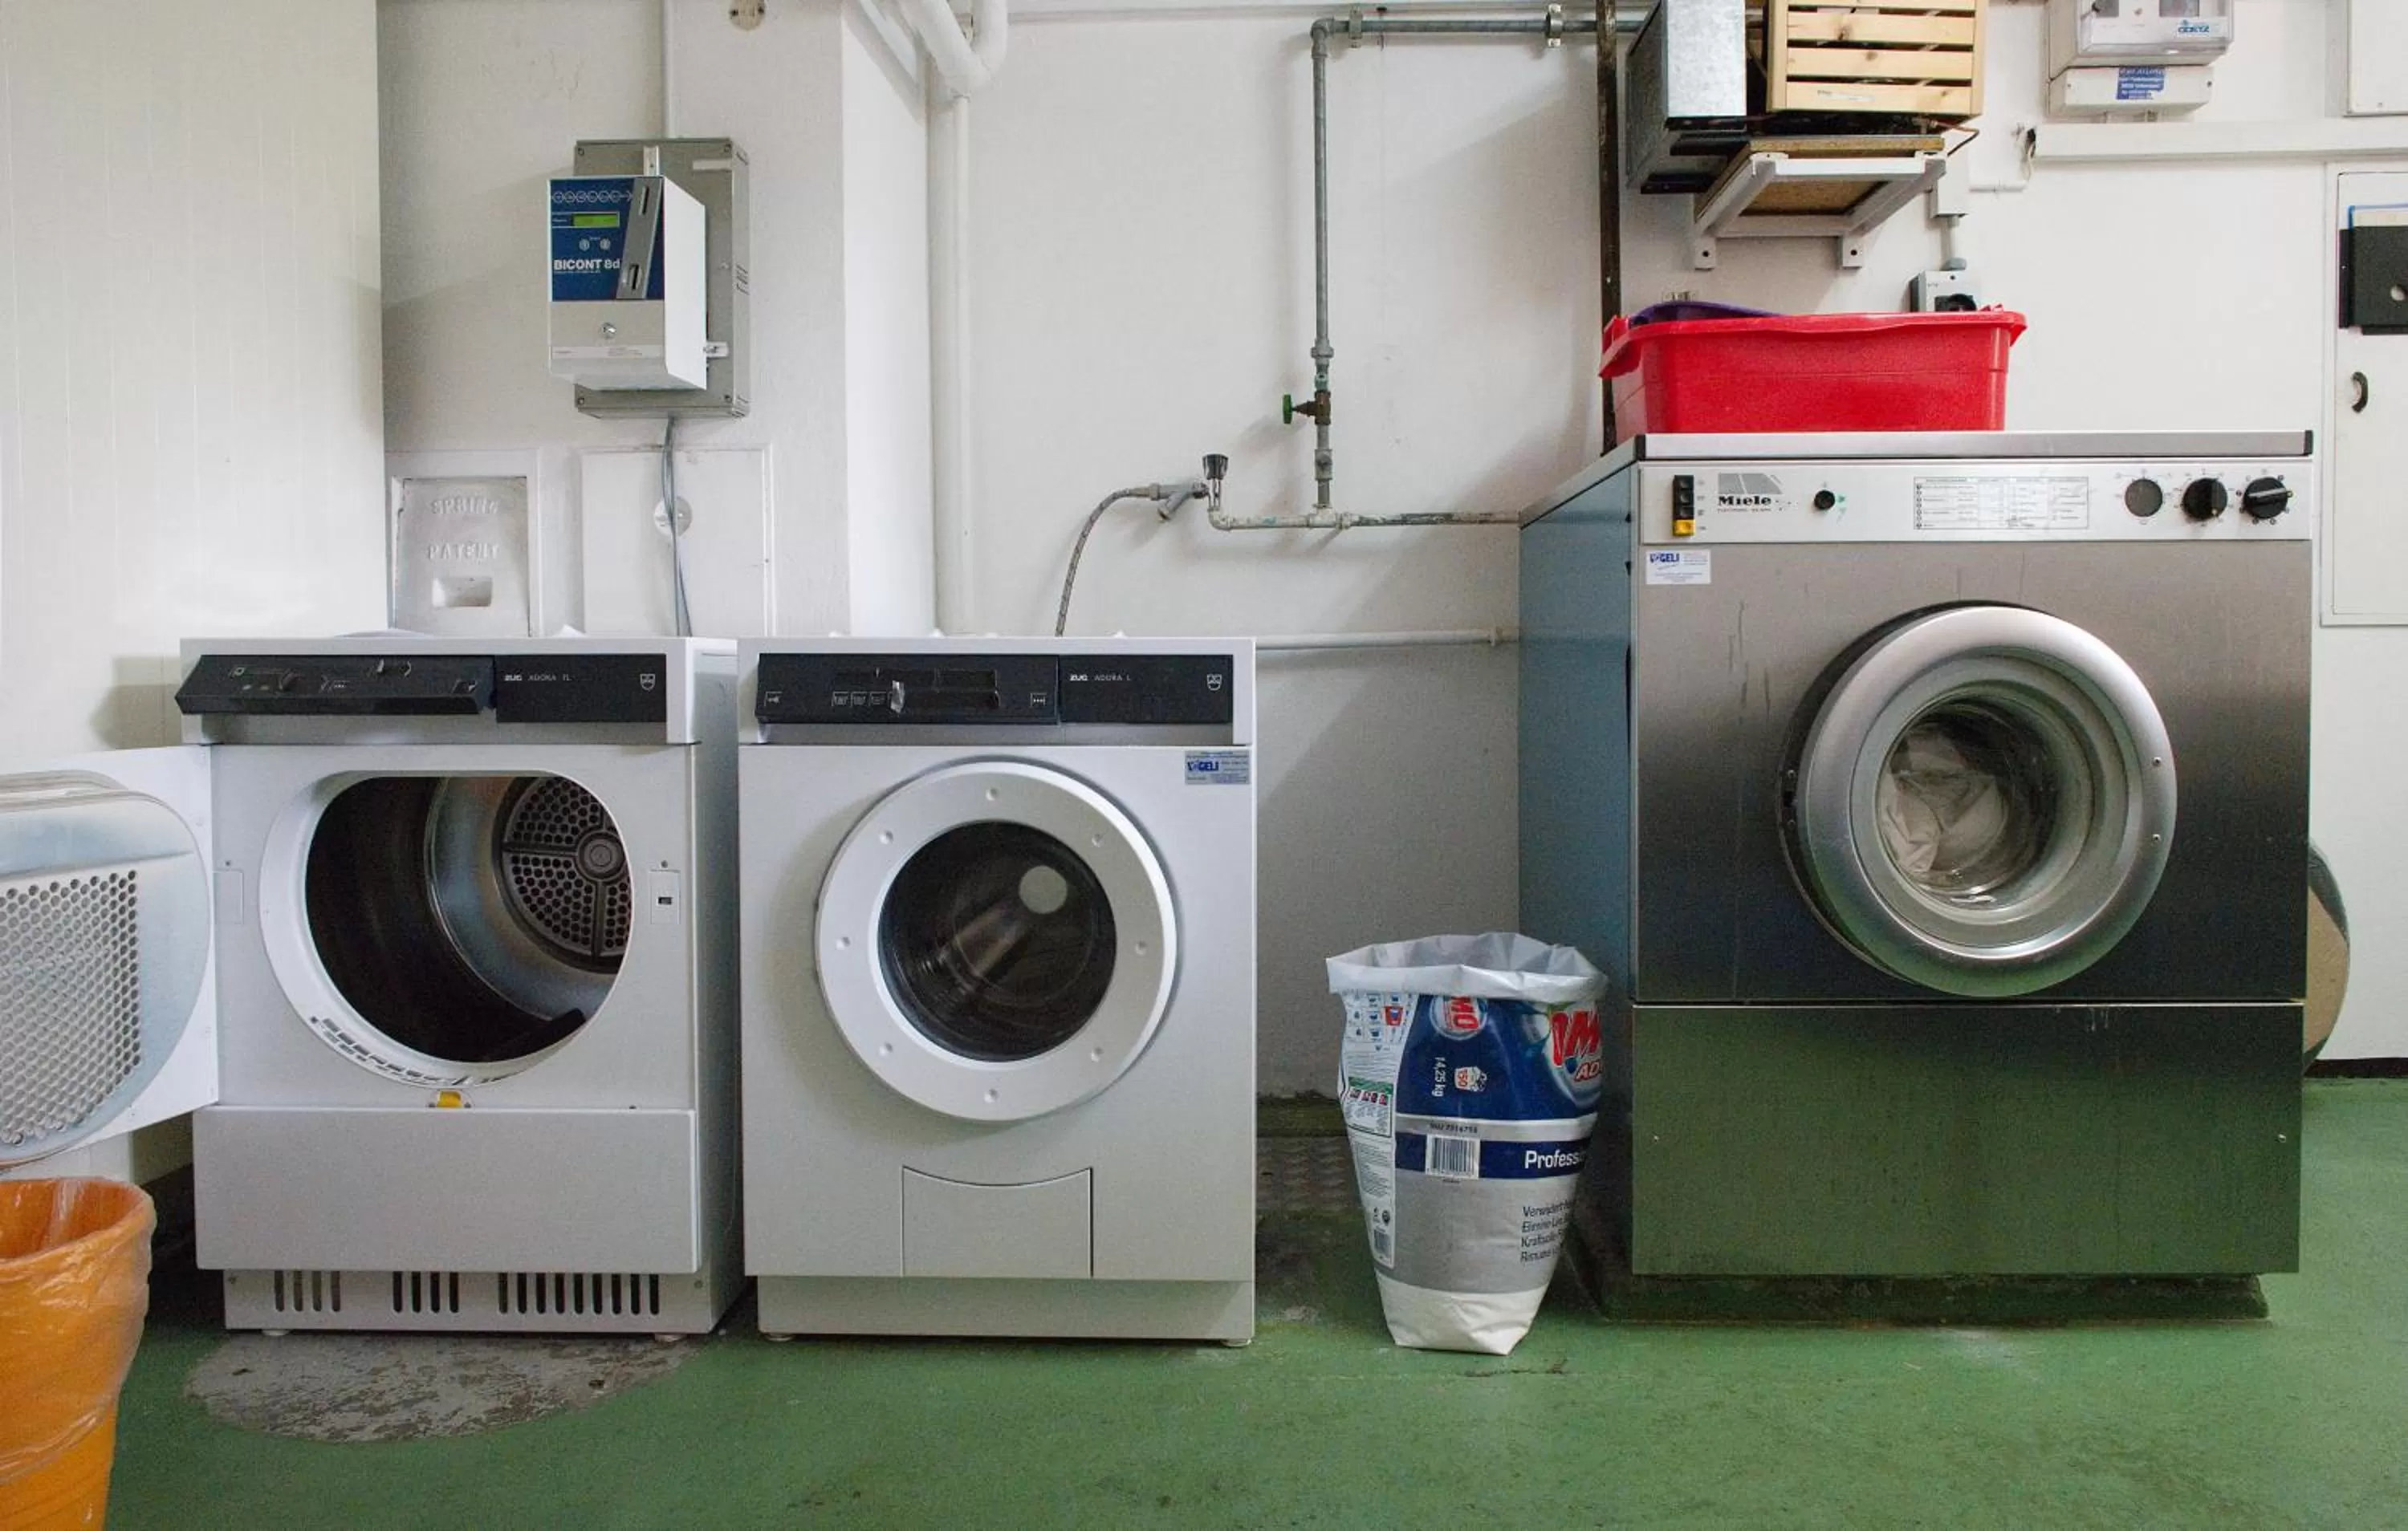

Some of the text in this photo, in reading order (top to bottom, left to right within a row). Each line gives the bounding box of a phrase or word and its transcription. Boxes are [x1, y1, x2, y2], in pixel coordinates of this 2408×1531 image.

[553, 258, 603, 270] BICONT
[1718, 495, 1771, 506] Miele
[1450, 995, 1479, 1029] MO
[1551, 1009, 1601, 1069] OM
[1573, 1059, 1603, 1083] AD
[1431, 1083, 1447, 1098] kg
